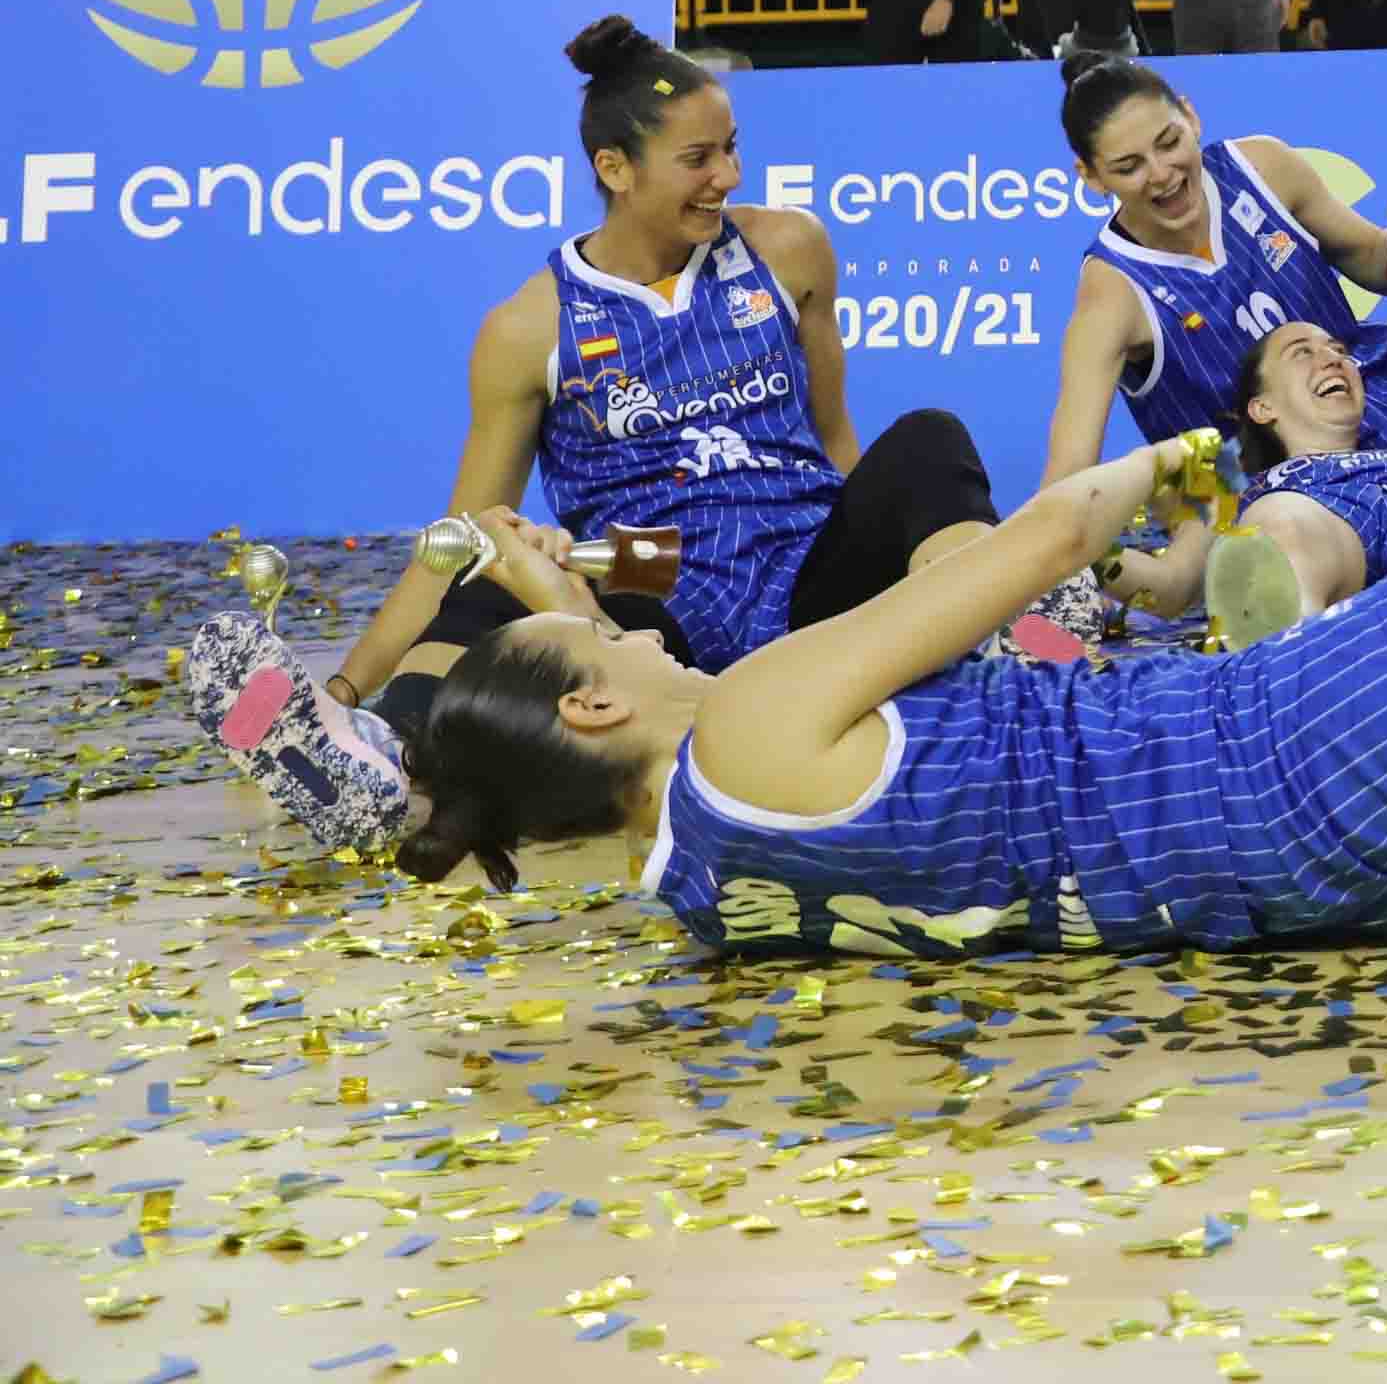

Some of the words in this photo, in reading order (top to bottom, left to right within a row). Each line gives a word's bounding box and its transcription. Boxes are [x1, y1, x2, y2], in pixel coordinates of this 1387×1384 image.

[0, 152, 96, 243] F
[119, 136, 564, 240] endesa
[845, 257, 1041, 278] MPORADA
[834, 285, 1041, 356] 020/21
[656, 351, 784, 399] PERFUMERIAS
